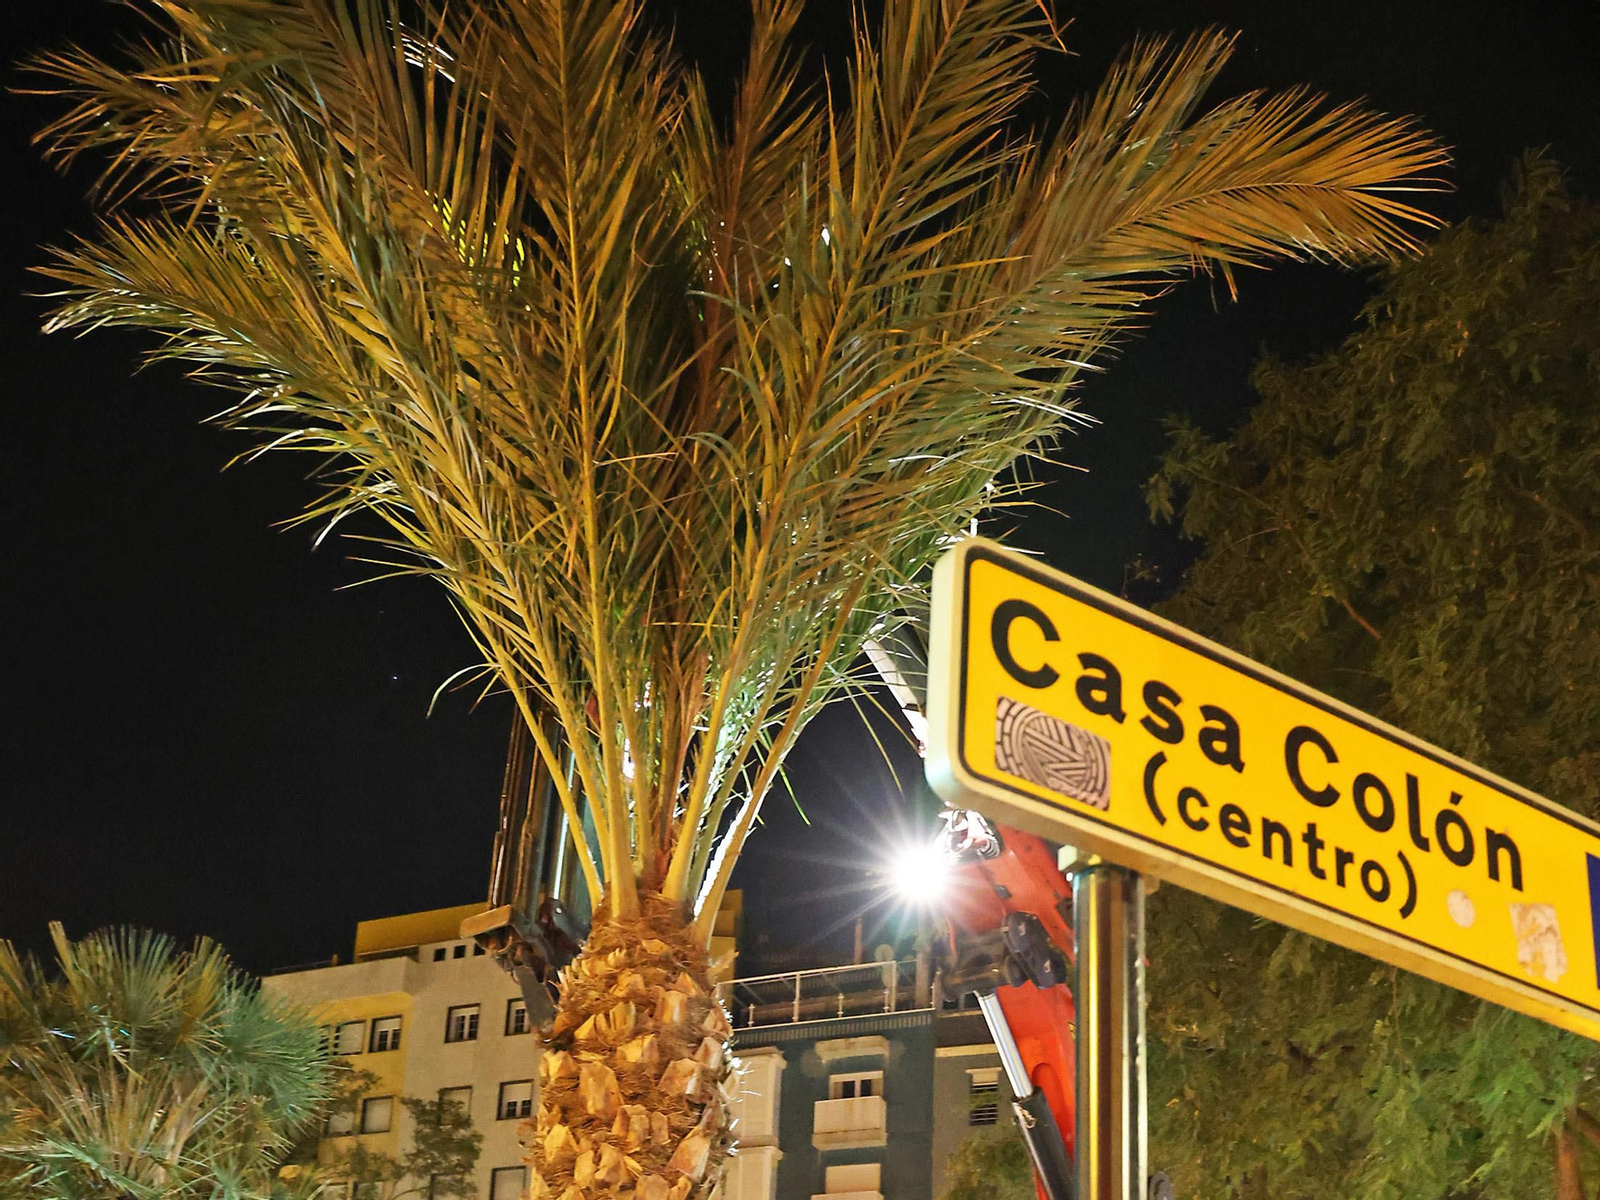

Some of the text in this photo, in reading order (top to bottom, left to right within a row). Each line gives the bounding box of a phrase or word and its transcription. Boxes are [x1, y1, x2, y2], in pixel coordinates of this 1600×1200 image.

[991, 599, 1524, 892] Casa Colón
[1143, 751, 1417, 919] (centro)
